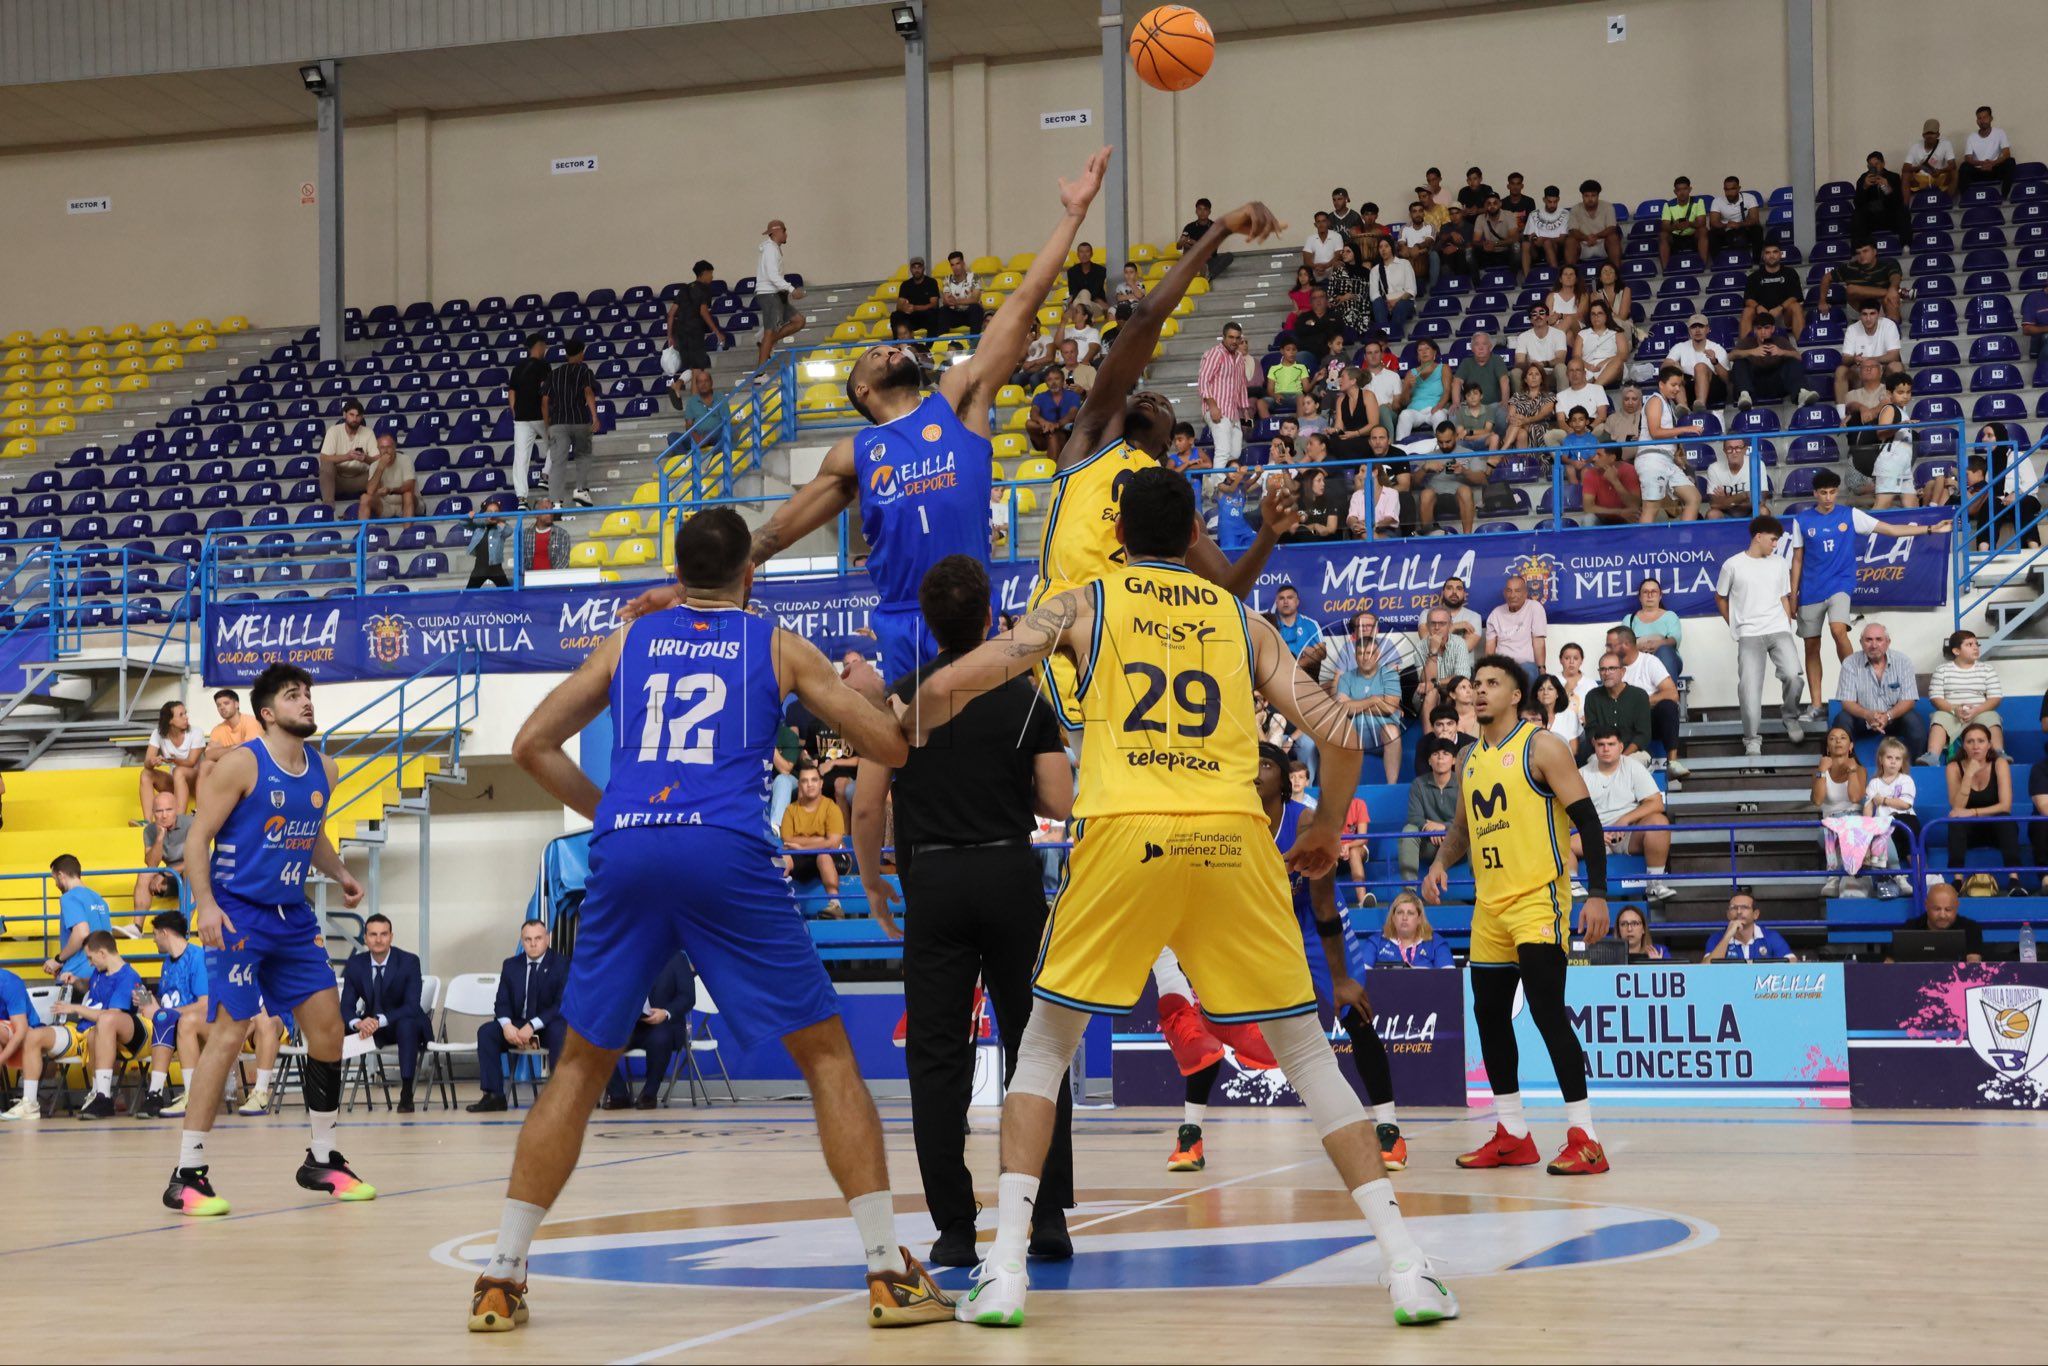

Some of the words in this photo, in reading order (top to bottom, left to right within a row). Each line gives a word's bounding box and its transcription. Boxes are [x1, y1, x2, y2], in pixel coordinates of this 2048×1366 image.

[1045, 115, 1076, 123] SECTOR
[1080, 114, 1087, 123] 3
[556, 161, 584, 169] SECTOR
[588, 160, 594, 168] 2
[101, 201, 107, 209] 1
[905, 473, 958, 496] DEPORTE
[918, 505, 930, 534] 1
[1822, 540, 1835, 552] 17
[1570, 555, 1624, 568] CIUDAD
[1628, 549, 1715, 566] AUTÓNOMA
[1322, 550, 1476, 595] MELILLA
[1856, 566, 1905, 581] EPORTE
[1125, 577, 1218, 606] GARINO
[774, 600, 820, 612] CIUDAD
[824, 594, 882, 609] AUTÓNO
[1324, 597, 1373, 612] CIUDAD
[1379, 595, 1404, 610] DEL
[217, 608, 340, 649] MELILLA
[417, 614, 459, 628] CIUDAD
[464, 612, 533, 626] AUTÓNOMA
[1133, 617, 1186, 642] MGS
[648, 638, 740, 659] KRUTOUS
[1160, 640, 1186, 651] Seguros
[217, 651, 259, 664] CIUDAD
[263, 651, 283, 662] DEL
[289, 648, 334, 663] DEPORTE
[1123, 661, 1221, 738] 29
[638, 673, 727, 765] 12
[1127, 749, 1220, 772] telepizza
[1194, 832, 1242, 842] Fundación
[1476, 819, 1510, 839] Estudiantes
[1170, 844, 1216, 856] Jiménez
[1220, 844, 1242, 855] Díaz
[1482, 847, 1503, 869] 51
[280, 862, 302, 886] 44
[228, 964, 252, 987] 44
[1616, 972, 1686, 999] CLUB
[1754, 973, 1826, 992] MELILLA
[1567, 1004, 1741, 1043] MELILLA
[1393, 1043, 1432, 1054] DEPORTE
[1583, 1050, 1753, 1079] ALONCESTO
